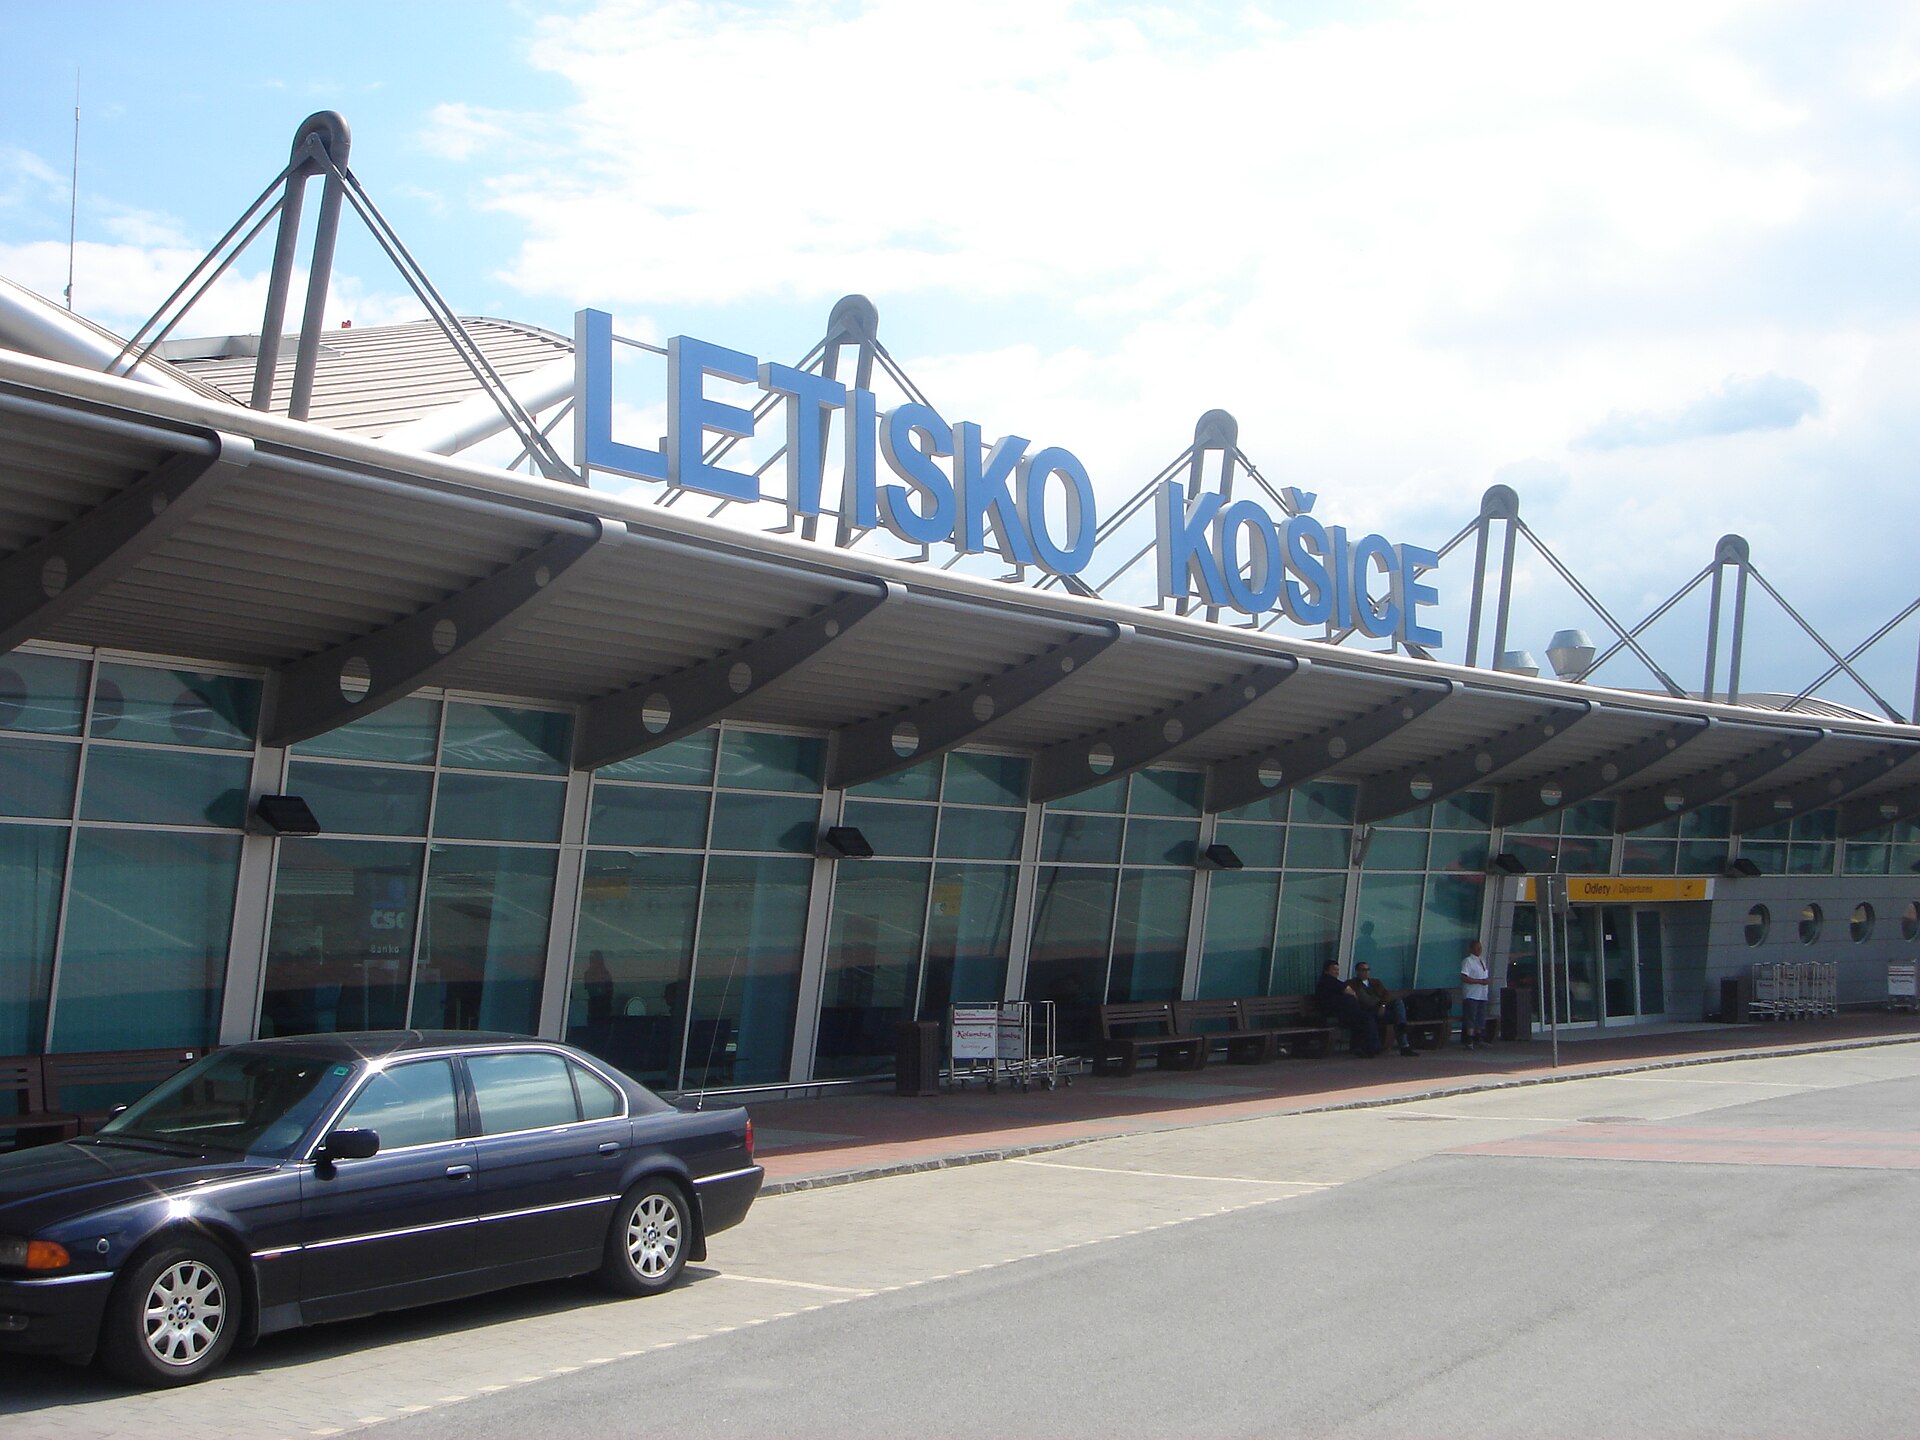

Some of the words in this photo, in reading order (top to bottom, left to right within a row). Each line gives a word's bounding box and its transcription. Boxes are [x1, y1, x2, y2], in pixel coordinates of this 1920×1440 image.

[574, 308, 1097, 576] LETISKO
[1156, 481, 1442, 649] KOŠICE
[1584, 882, 1610, 895] Odlety
[1619, 884, 1653, 894] Departures
